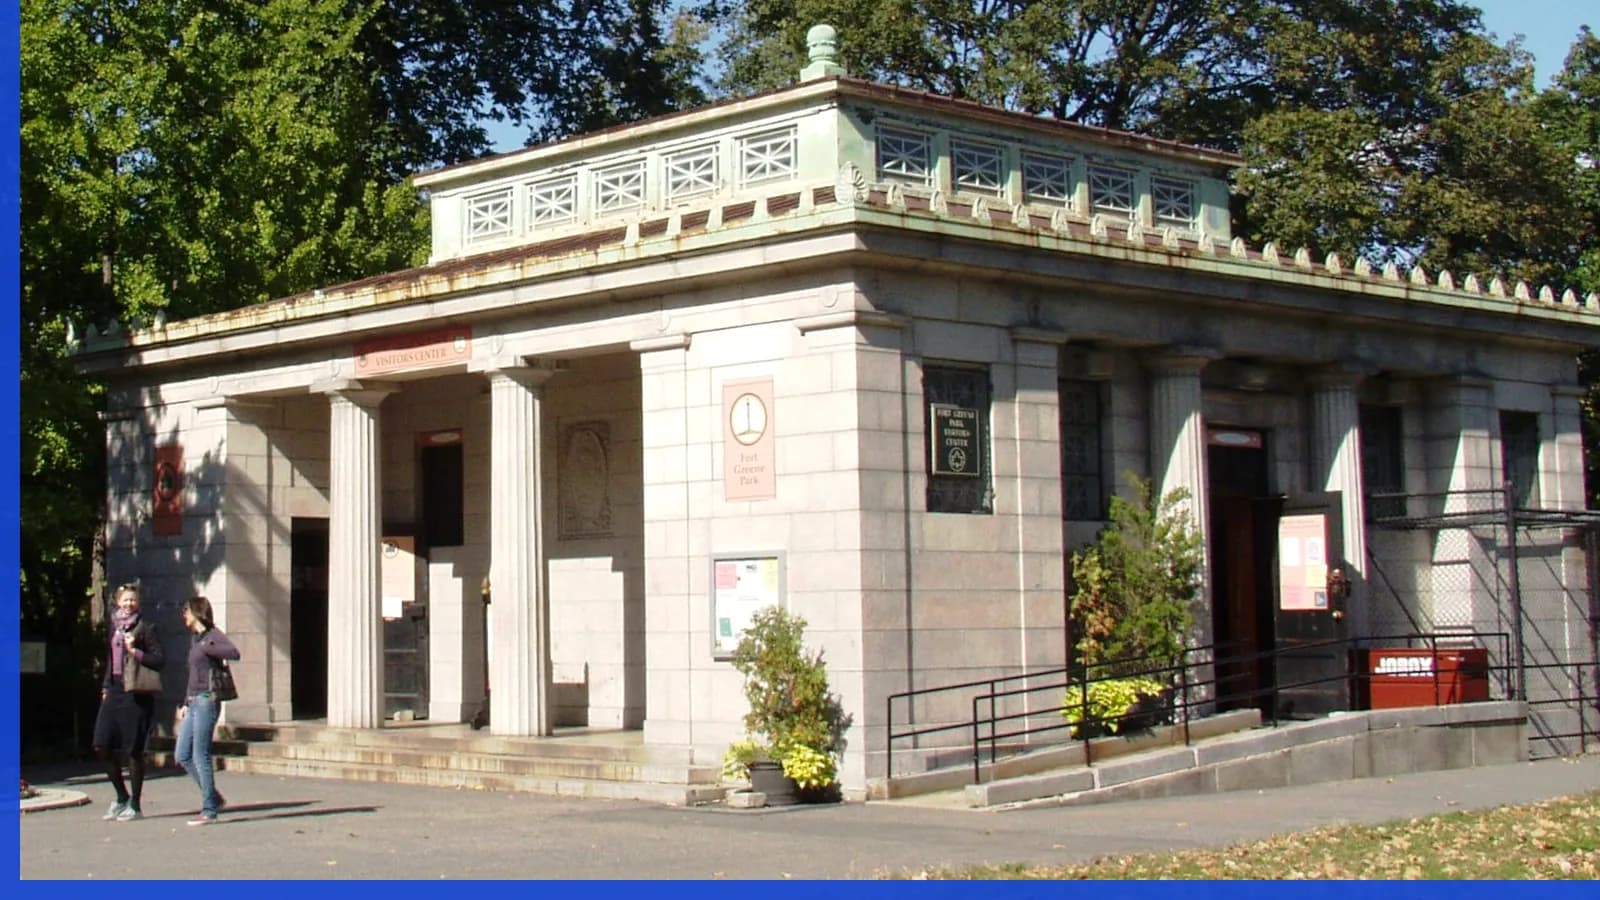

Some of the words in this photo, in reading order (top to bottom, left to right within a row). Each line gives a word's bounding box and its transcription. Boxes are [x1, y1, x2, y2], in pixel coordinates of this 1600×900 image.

[375, 350, 414, 366] VISITORS
[414, 347, 447, 361] CENTER
[734, 464, 765, 474] Greene
[740, 474, 759, 486] Park
[1374, 656, 1435, 677] JOBOX
